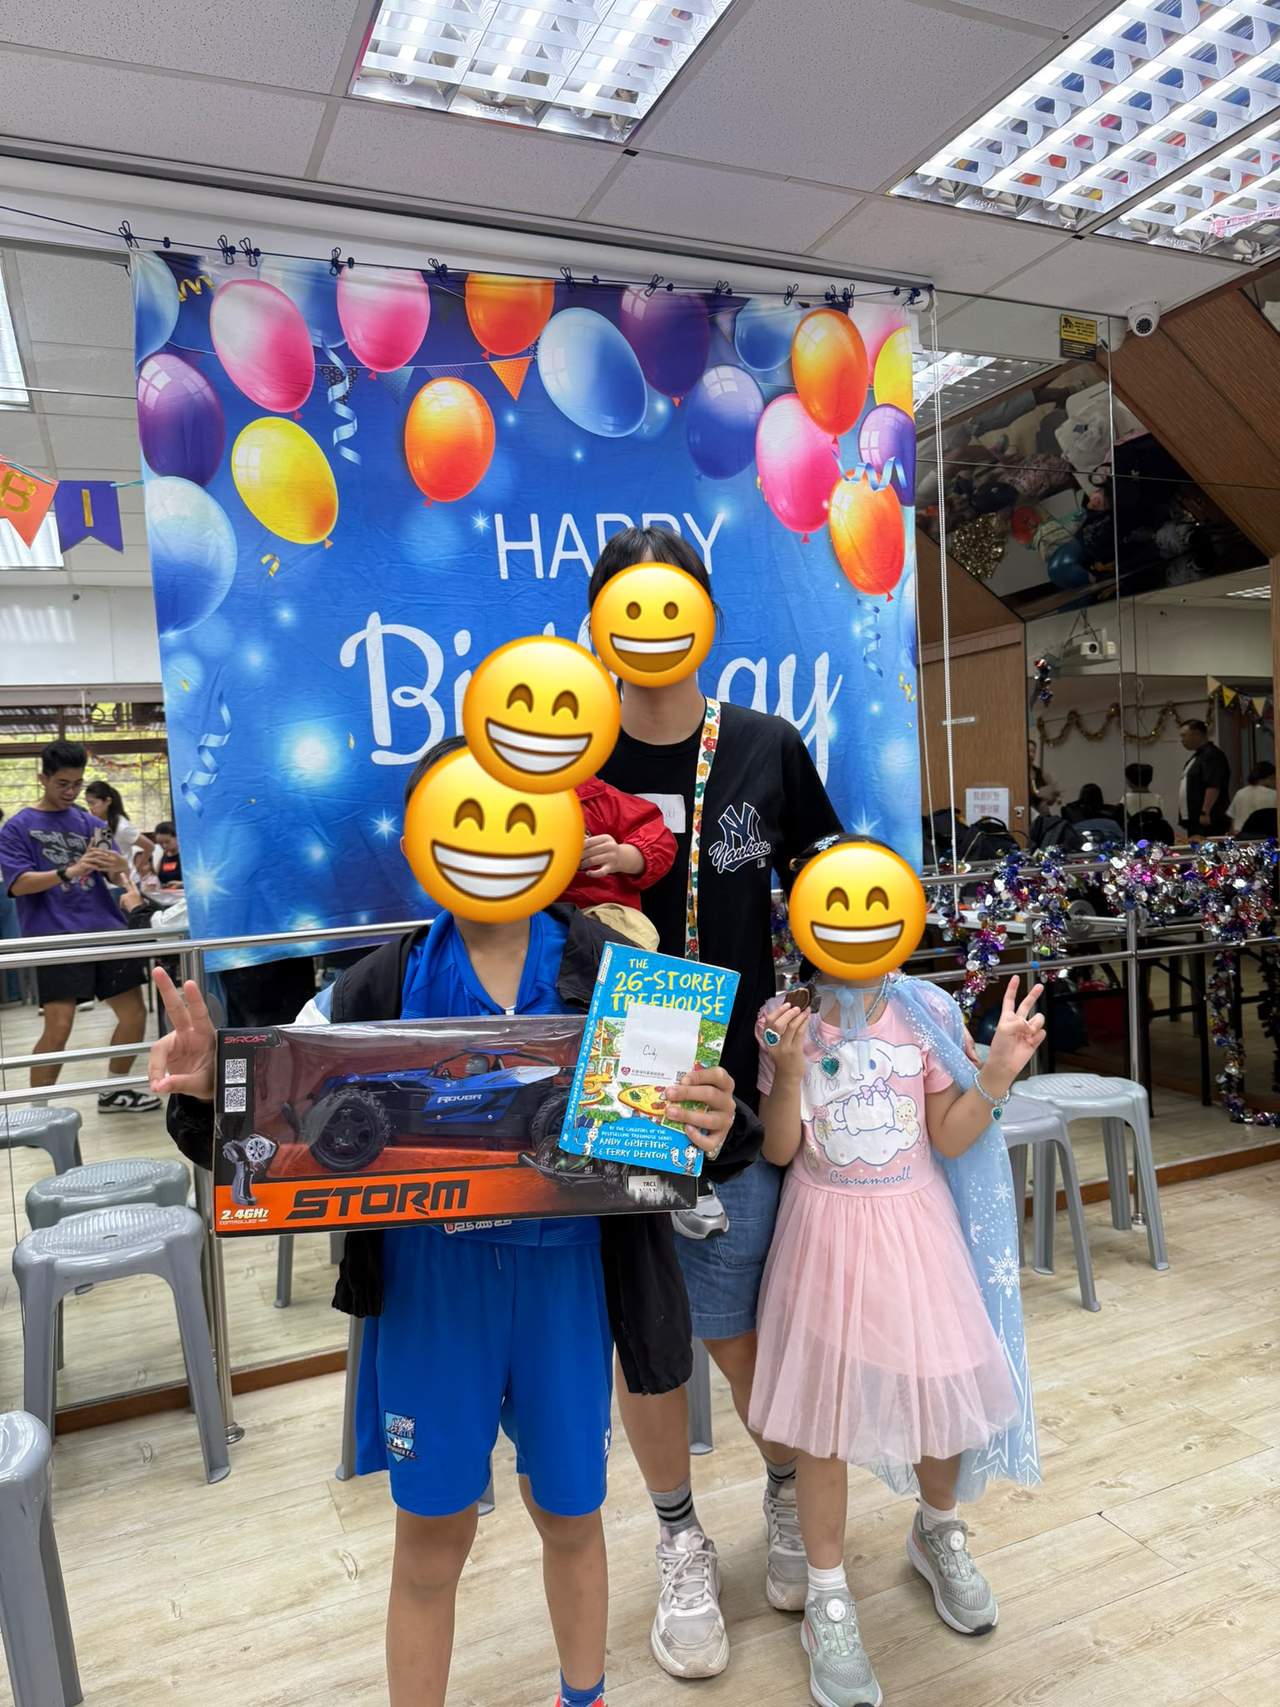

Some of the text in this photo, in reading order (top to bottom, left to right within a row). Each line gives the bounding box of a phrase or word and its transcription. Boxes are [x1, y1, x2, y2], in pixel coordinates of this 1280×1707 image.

[708, 839, 771, 874] Yankees
[629, 958, 649, 969] THE
[615, 970, 726, 994] 26-STOREY
[599, 1137, 622, 1146] ANDY
[606, 1147, 632, 1158] TERRY
[633, 1149, 668, 1160] DENTON
[829, 1165, 913, 1184] Cinnamoroll
[285, 1179, 471, 1221] STORM
